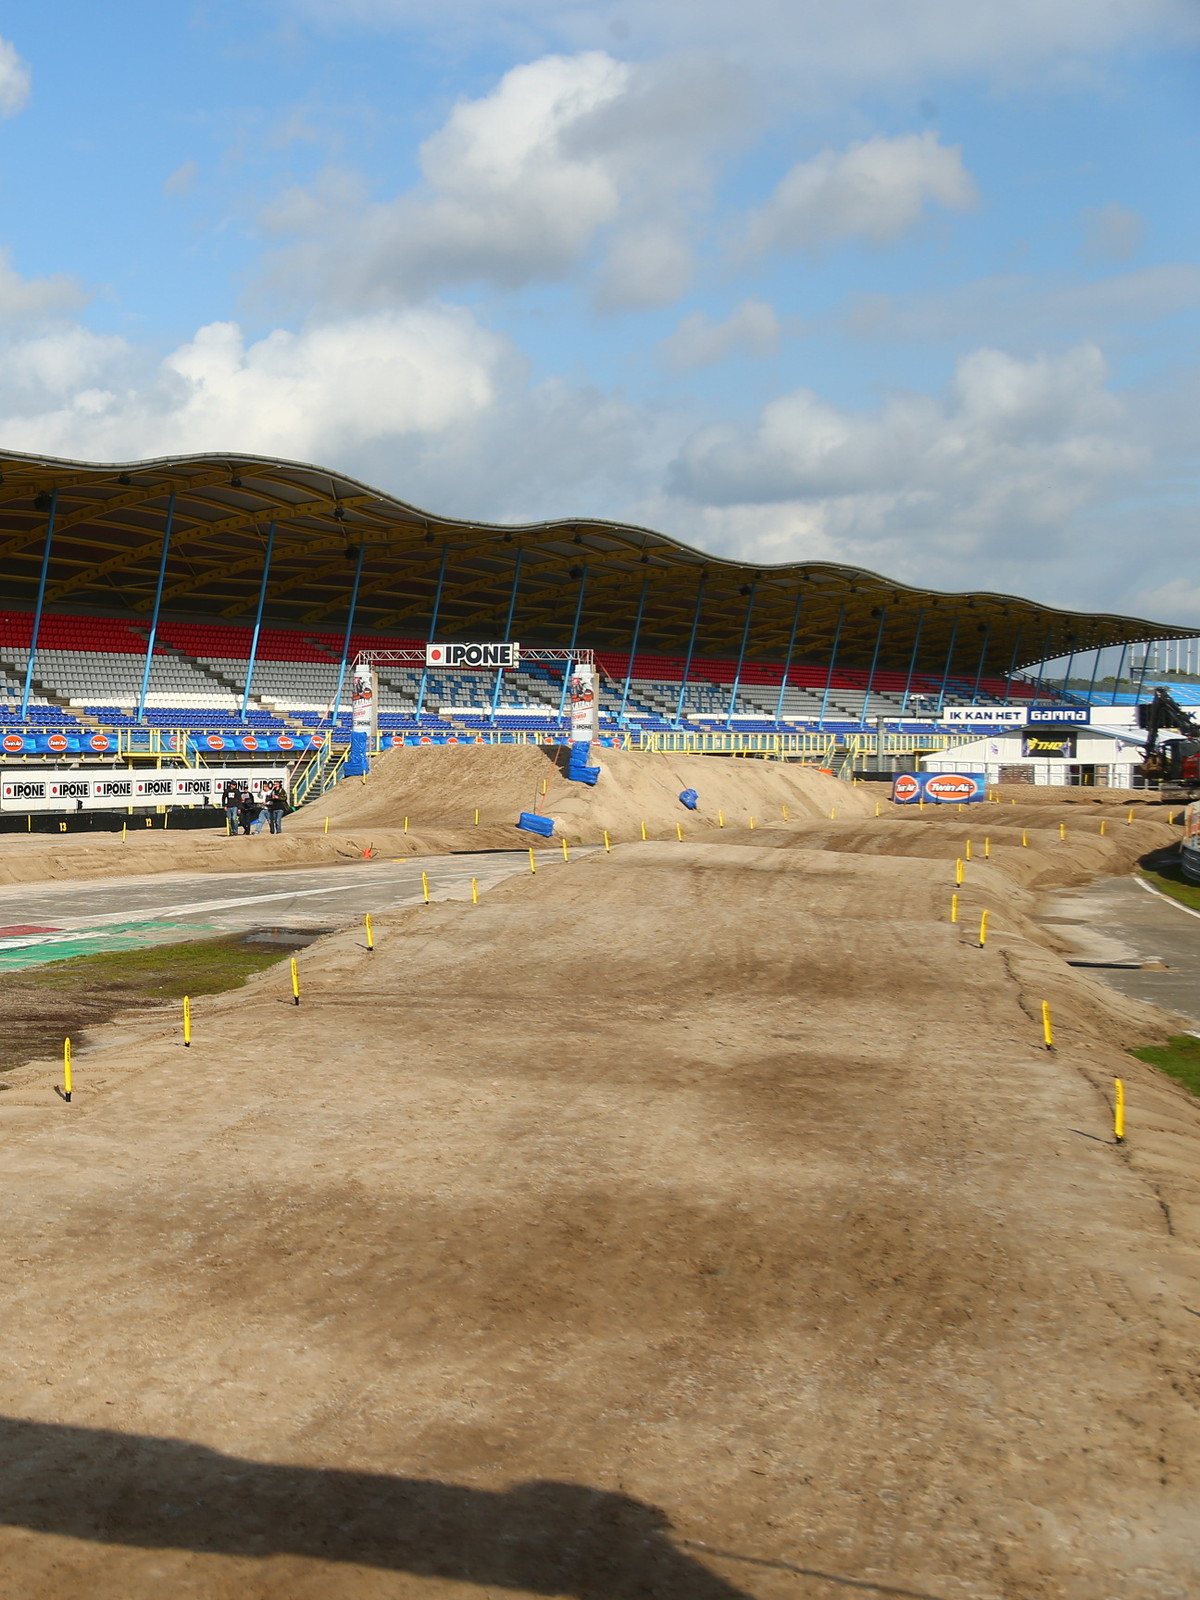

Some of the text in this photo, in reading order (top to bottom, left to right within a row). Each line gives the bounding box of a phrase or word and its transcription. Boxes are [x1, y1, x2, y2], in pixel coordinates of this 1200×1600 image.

[445, 645, 511, 664] IPONE
[949, 711, 1022, 720] IK KAN HET
[13, 784, 45, 796] IPONE
[59, 784, 88, 796] IPONE
[103, 782, 131, 794] IPONE
[144, 781, 172, 794] IPONE
[185, 780, 211, 793] IPONE
[930, 783, 974, 792] Twin Air
[59, 822, 67, 832] 13
